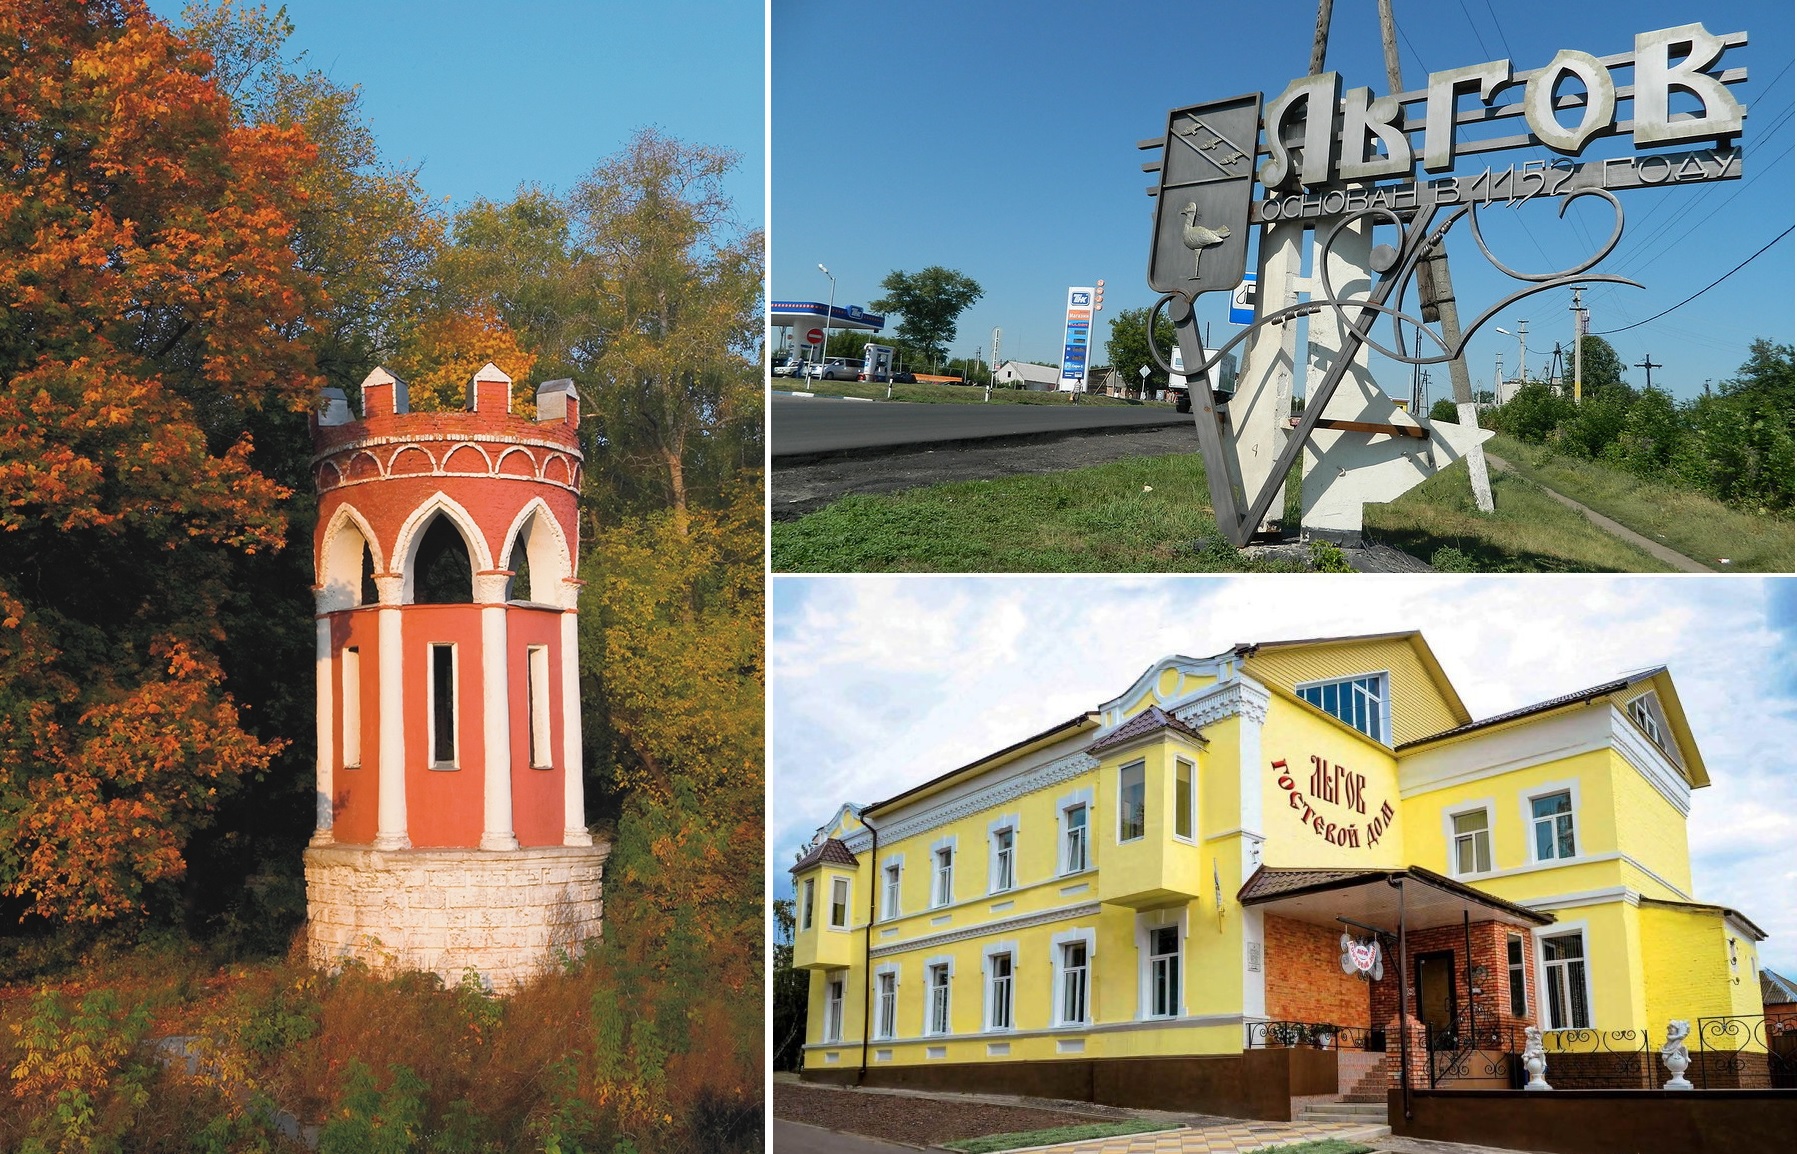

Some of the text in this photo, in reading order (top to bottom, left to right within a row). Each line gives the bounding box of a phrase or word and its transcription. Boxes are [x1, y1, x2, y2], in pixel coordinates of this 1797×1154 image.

[1260, 145, 1742, 221] ОСНОВАН В 1152 ГОДУ
[1270, 758, 1395, 849] ГОСТЕВОЙ ДОМ
[1310, 754, 1367, 815] ЛЬГОВ
